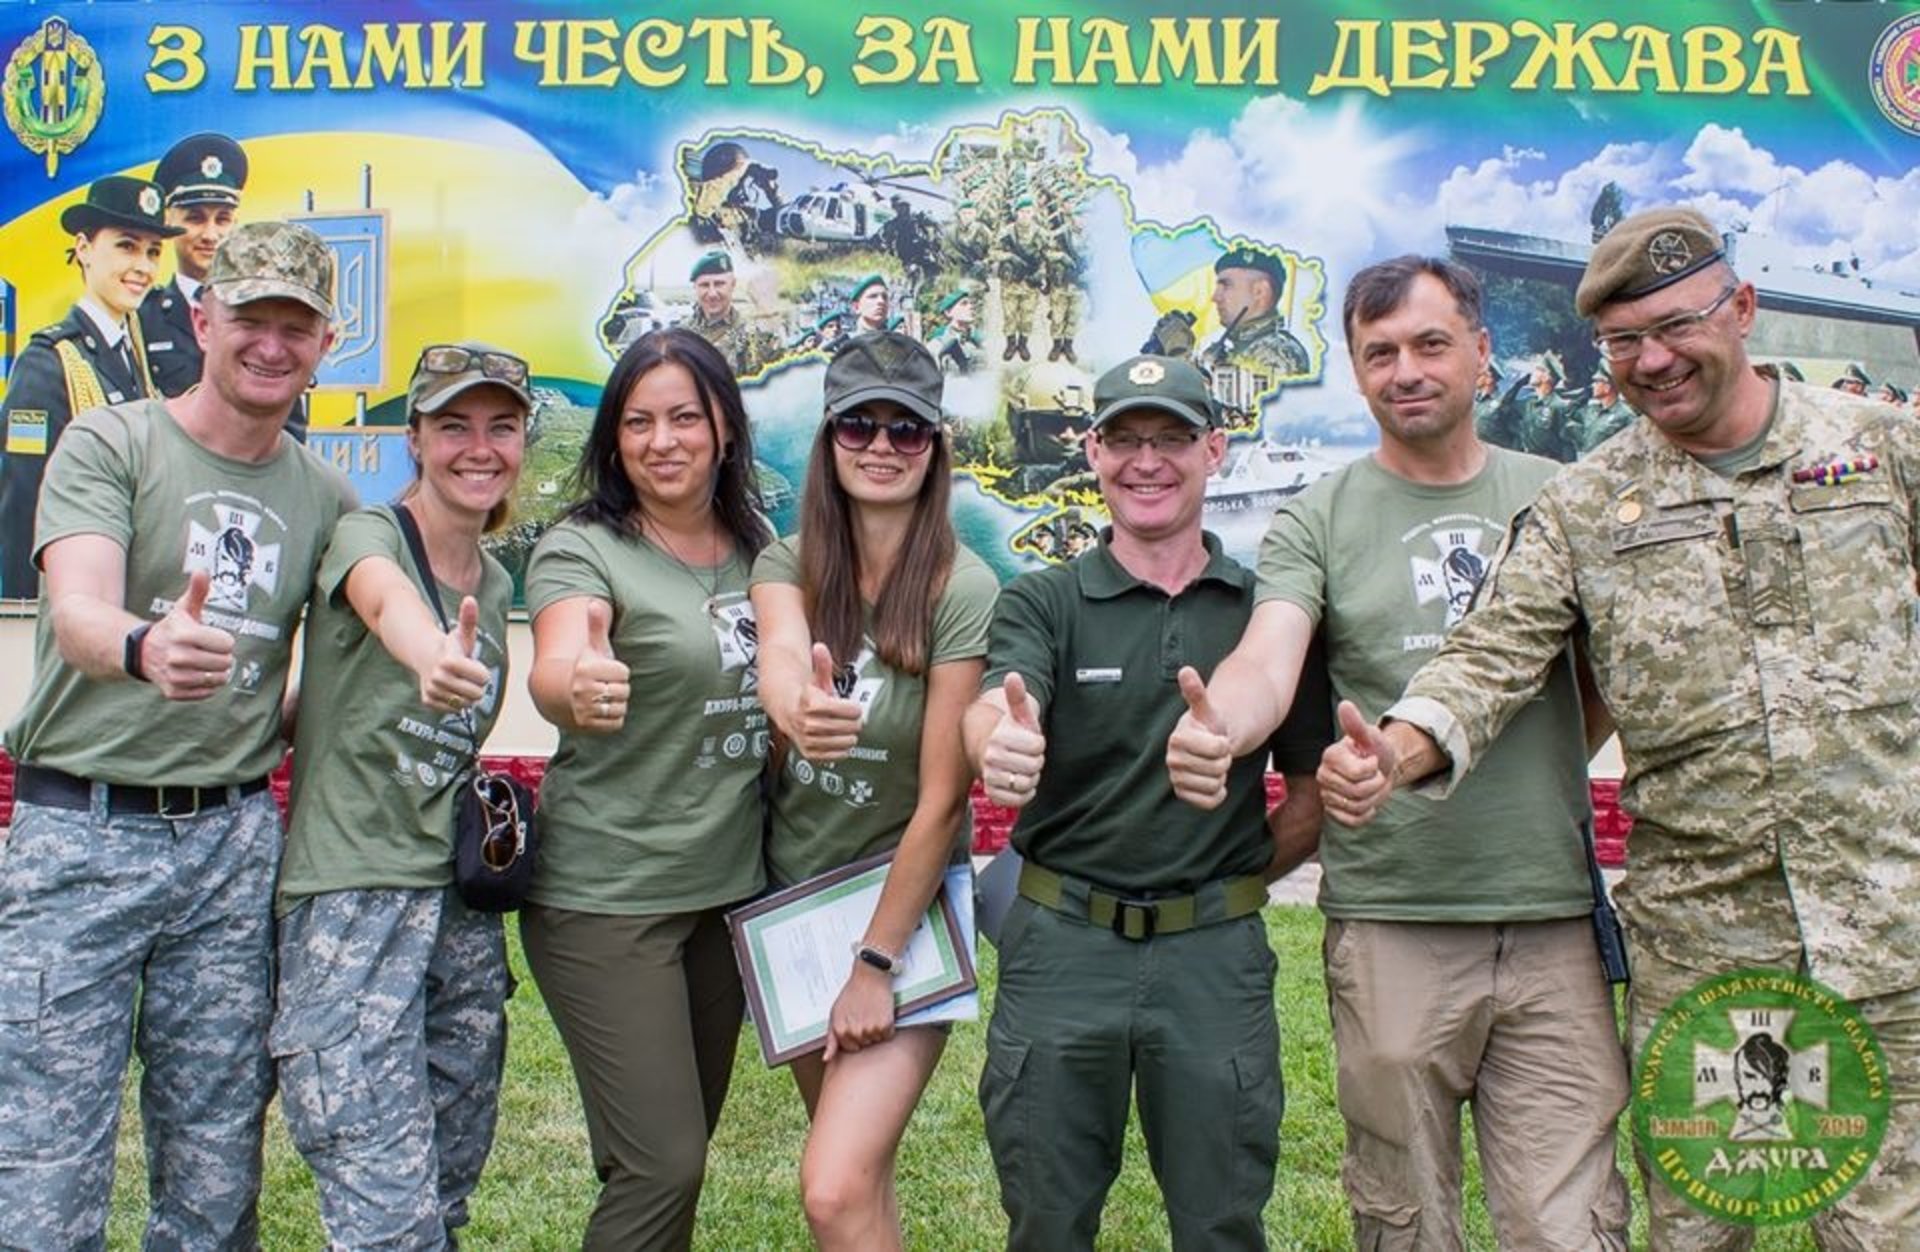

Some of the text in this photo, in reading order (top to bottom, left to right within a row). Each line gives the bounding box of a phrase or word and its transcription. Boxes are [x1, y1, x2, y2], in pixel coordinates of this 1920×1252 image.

[146, 24, 206, 94] З
[236, 22, 486, 92] НАМИ
[514, 18, 824, 97] ЧЕСТЬ,
[853, 17, 979, 88] ЗА
[1013, 17, 1279, 87] НАМИ
[1308, 17, 1811, 97] ДЕРЖАВА
